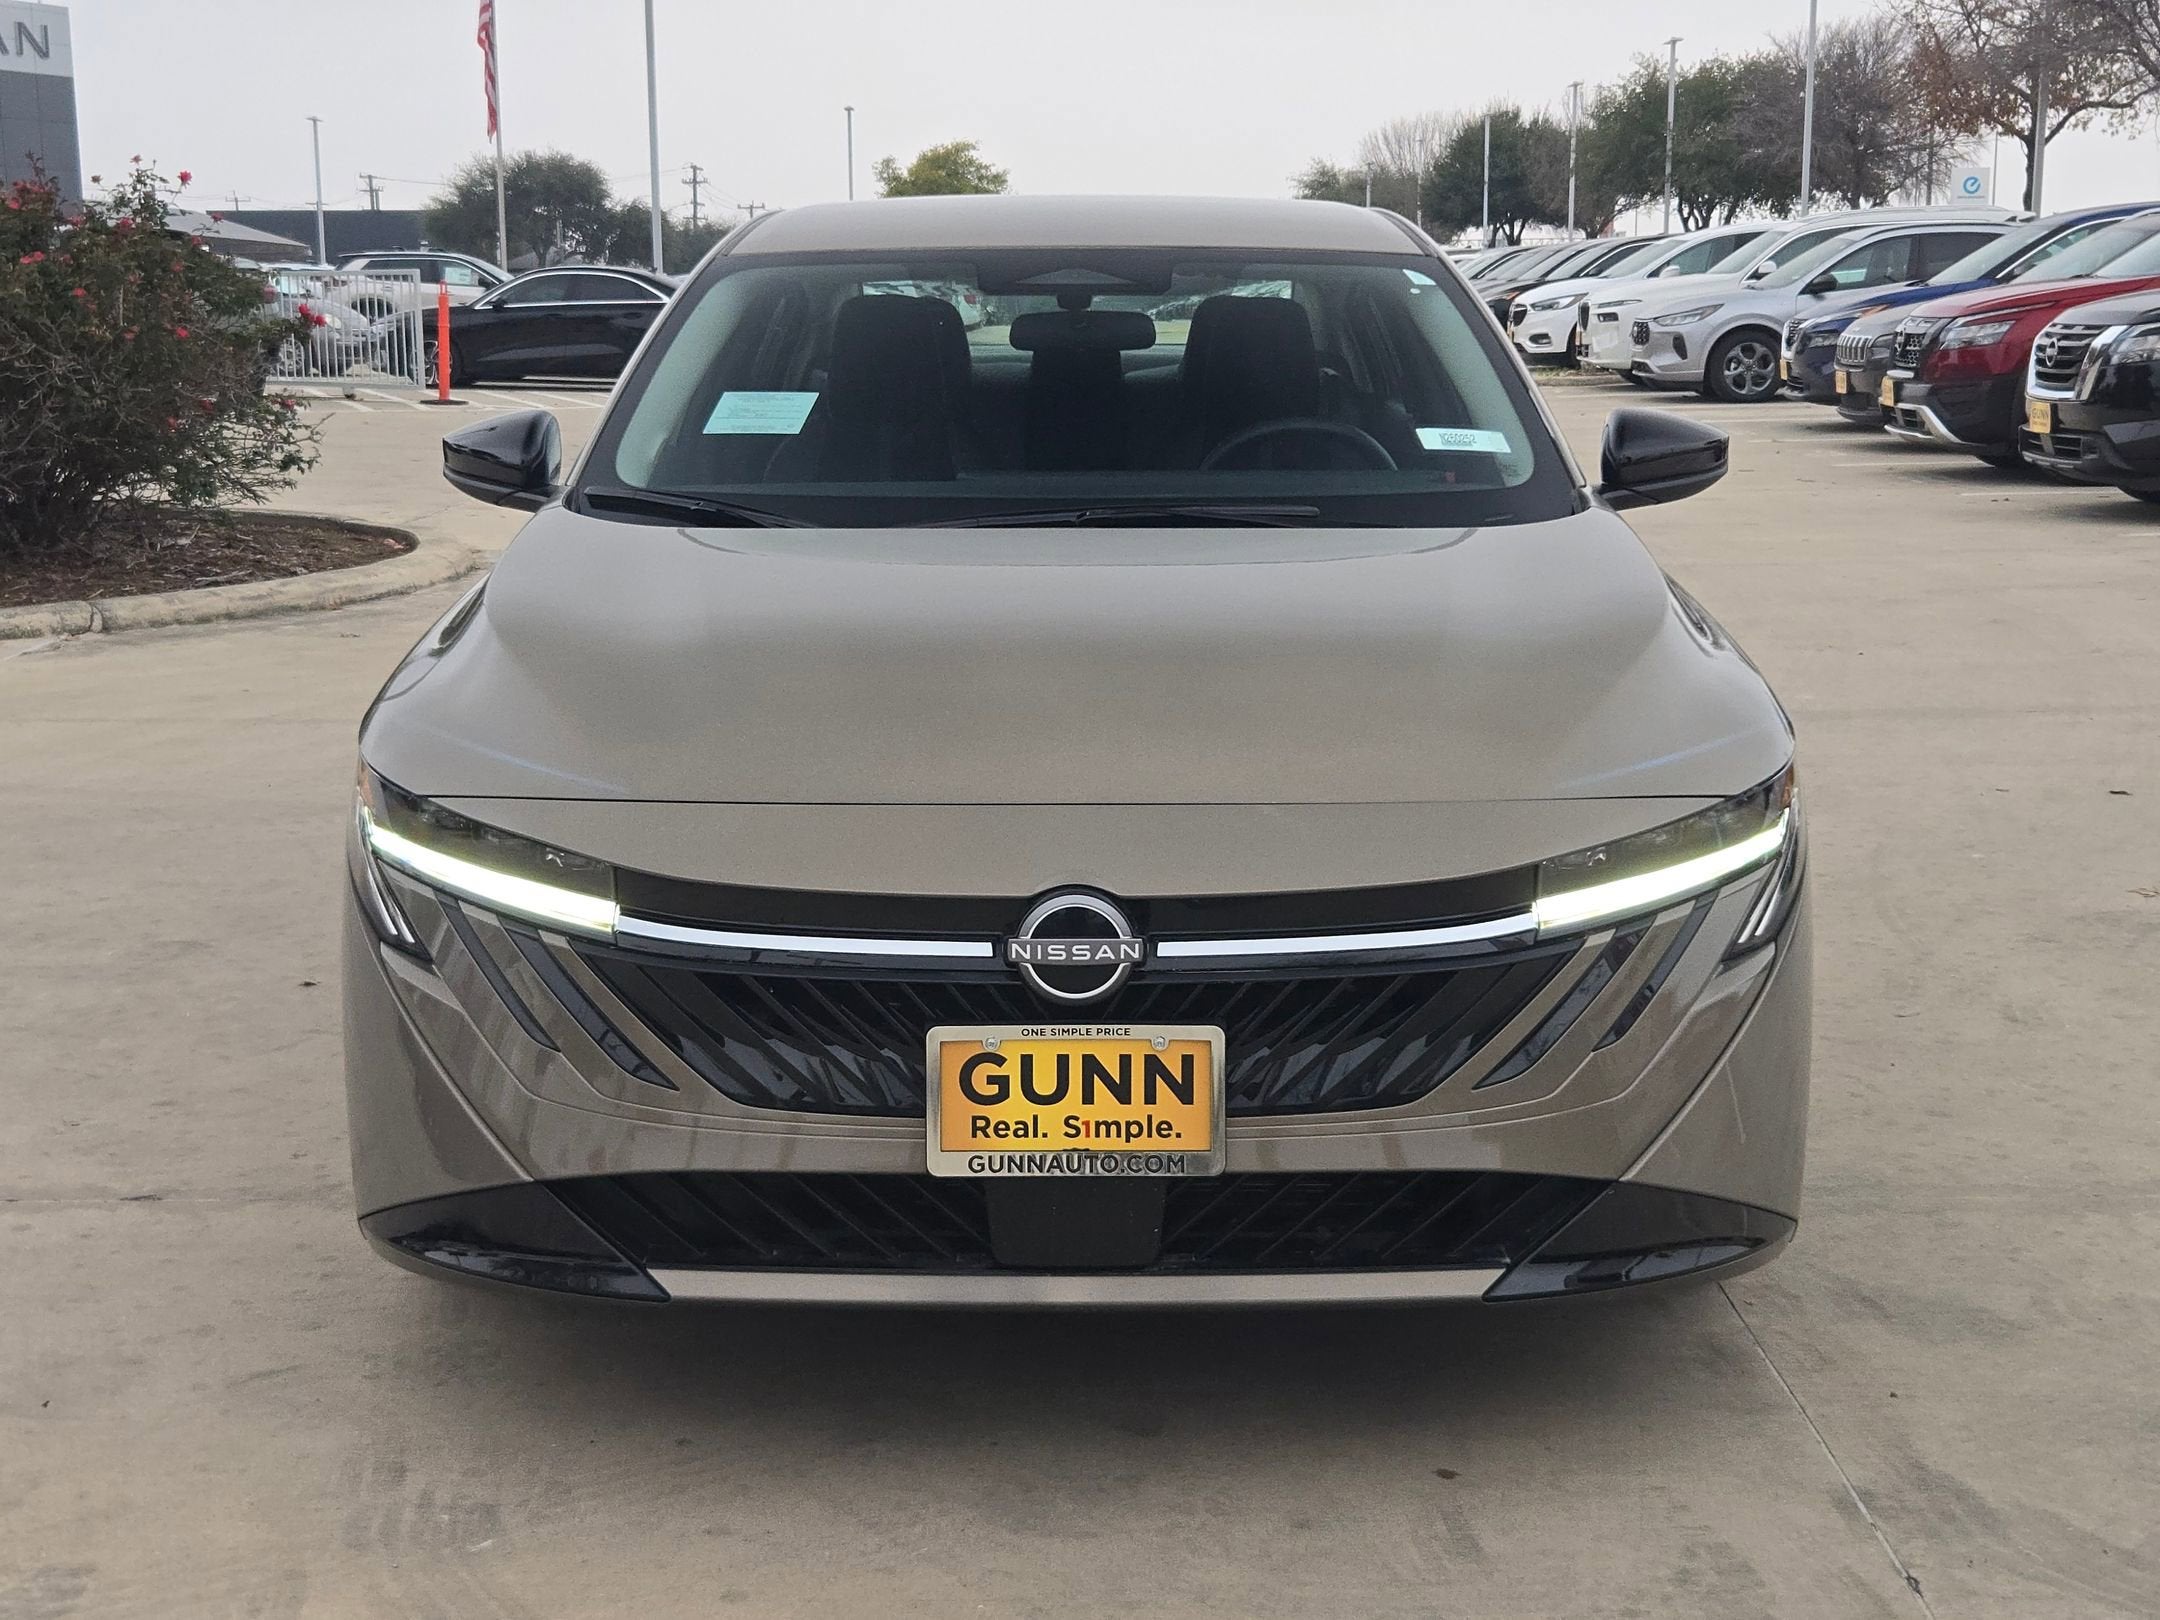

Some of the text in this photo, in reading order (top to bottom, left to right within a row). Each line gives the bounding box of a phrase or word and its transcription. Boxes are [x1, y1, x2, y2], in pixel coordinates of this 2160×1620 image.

[1011, 943, 1140, 961] NISSAN
[1021, 1027, 1131, 1037] ONE SIMPLE PRICE
[958, 1051, 1195, 1106] GUNN
[971, 1114, 1049, 1139] Real.
[967, 1154, 1185, 1174] GUNNAUTO.COM
